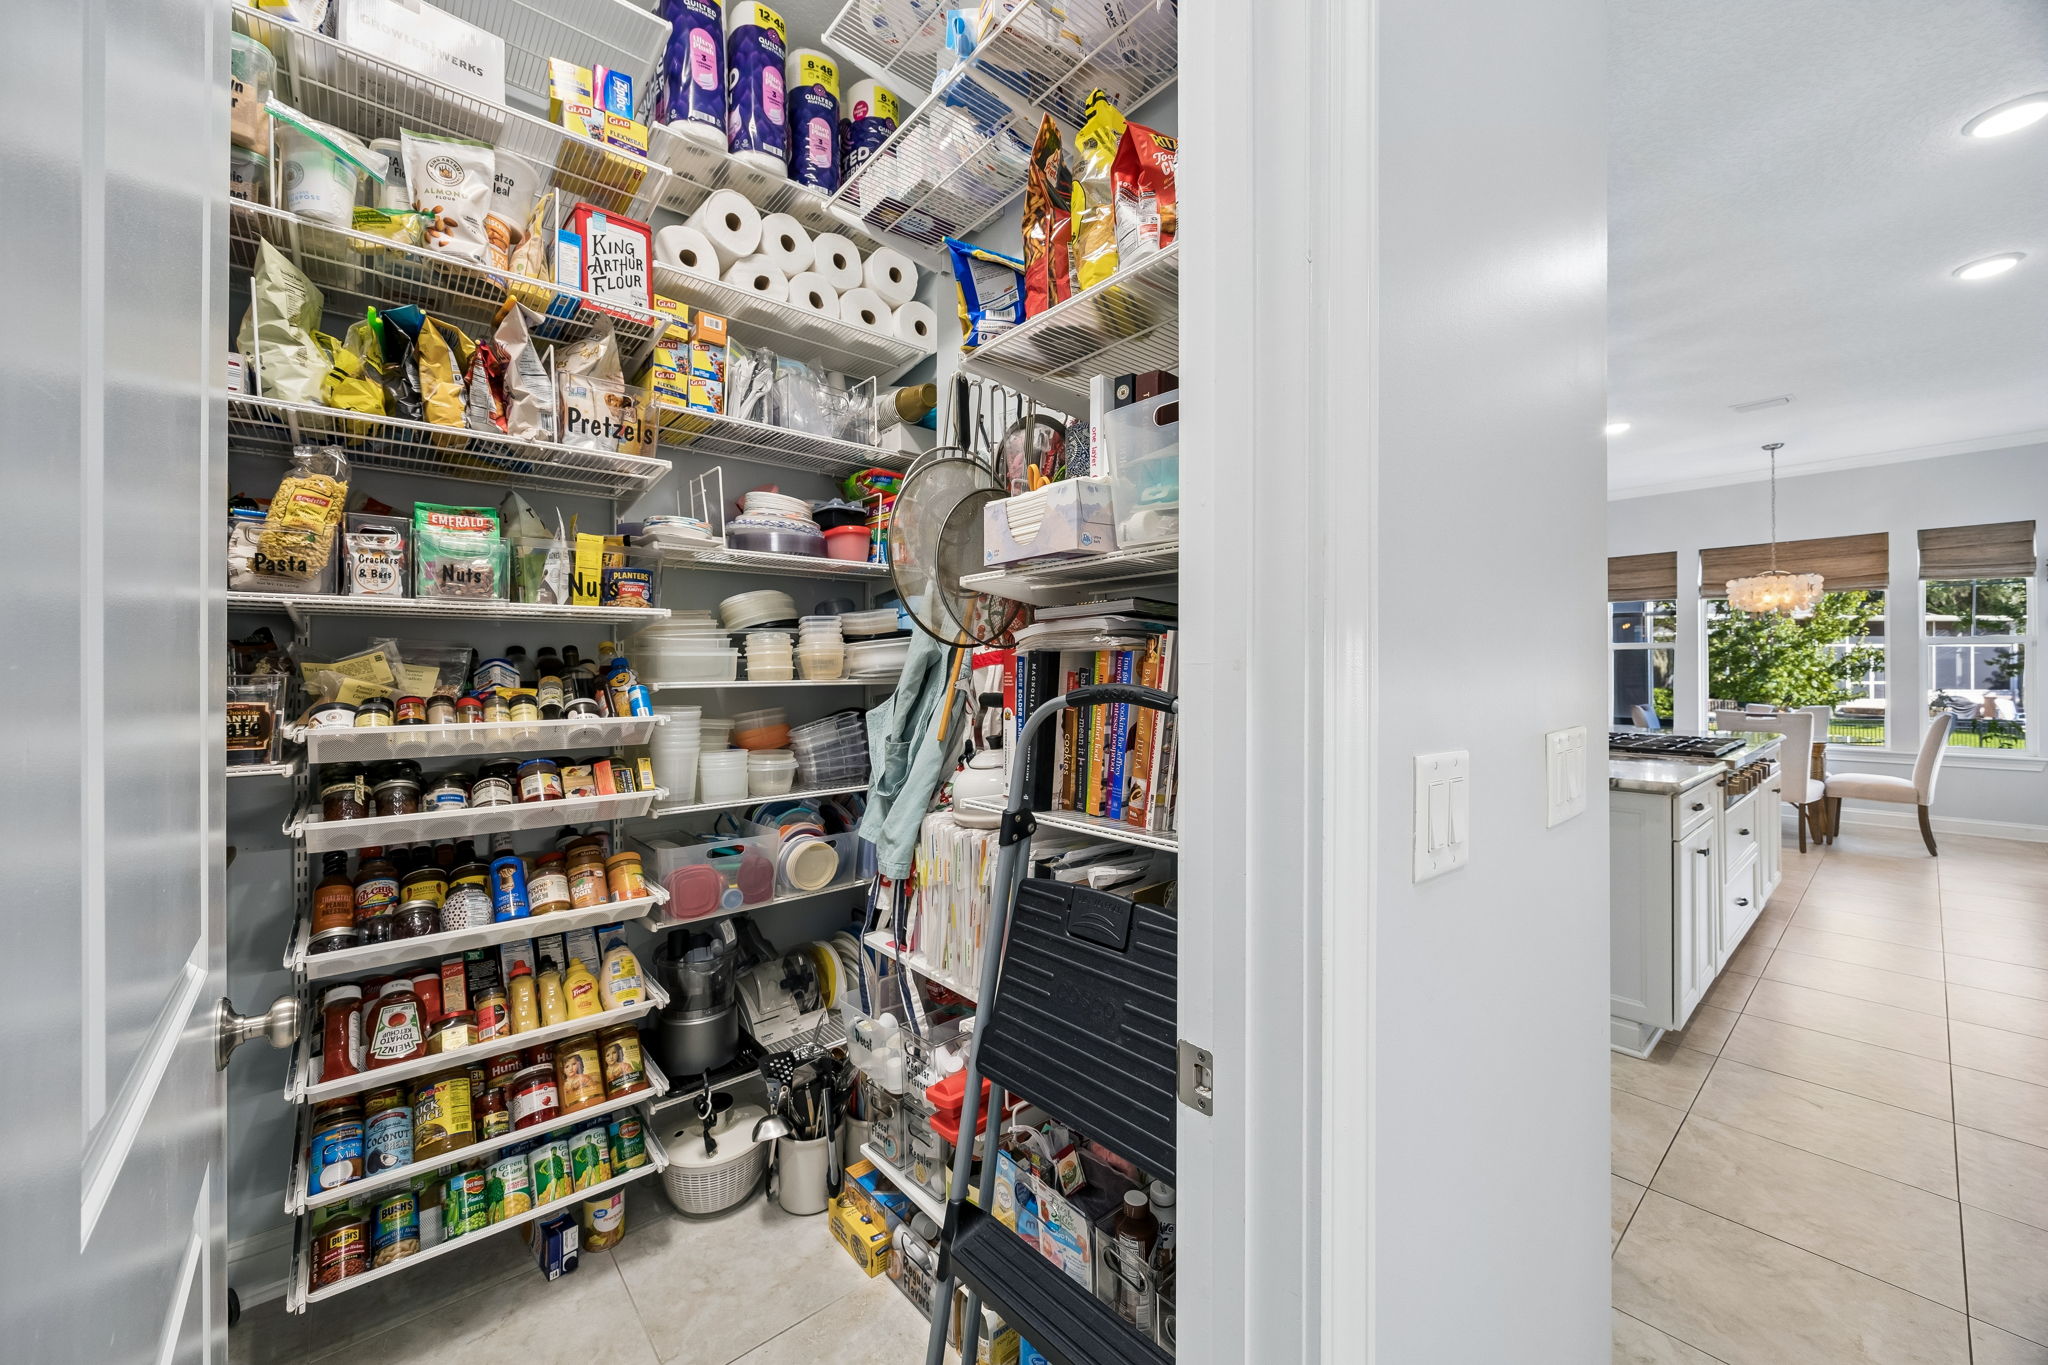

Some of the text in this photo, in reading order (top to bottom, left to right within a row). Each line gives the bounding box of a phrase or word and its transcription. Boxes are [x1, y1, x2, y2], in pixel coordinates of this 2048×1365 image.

[612, 76, 630, 111] Ziploc
[804, 93, 834, 107] QUILTED
[565, 104, 591, 115] GLAD
[608, 116, 630, 127] GLAD
[494, 173, 515, 187] atzo
[591, 234, 635, 258] KING
[587, 256, 644, 276] ARTHUR
[592, 275, 642, 296] FLOUR
[657, 300, 676, 308] GLAD
[656, 341, 677, 349] GLAD
[655, 371, 675, 379] GLAD
[567, 406, 653, 445] Pretzels
[431, 513, 484, 528] EMERALD
[254, 552, 307, 573] Pasta
[358, 553, 399, 565] Crackers
[358, 568, 392, 580] & Bars
[442, 564, 482, 583] Nuts
[613, 572, 649, 581] PLANTERS
[568, 571, 619, 598] Nuts
[1029, 663, 1037, 708] MAGNOLIA
[1117, 703, 1126, 735] cooking
[1078, 719, 1086, 755] mean it
[1093, 708, 1103, 762] comfort food
[1063, 733, 1071, 776] cookies
[1113, 750, 1124, 777] Jeffrey
[1135, 739, 1145, 770] JULIA
[571, 881, 594, 894] Peter
[379, 1032, 414, 1045] TOMATO
[382, 1027, 412, 1038] KETCHUP
[855, 1028, 873, 1052] Decaf
[381, 1041, 412, 1054] HEINZ
[906, 1056, 930, 1080] Regular
[415, 1099, 440, 1116] UCK
[366, 1129, 410, 1150] COCONUT
[335, 1150, 358, 1162] Milk
[498, 1159, 523, 1172] Green
[909, 1144, 932, 1169] Regular
[381, 1200, 414, 1219] BUSH'S
[331, 1229, 359, 1247] BUSH'S
[903, 1256, 931, 1295] Regular
[904, 1272, 930, 1312] Flavors
